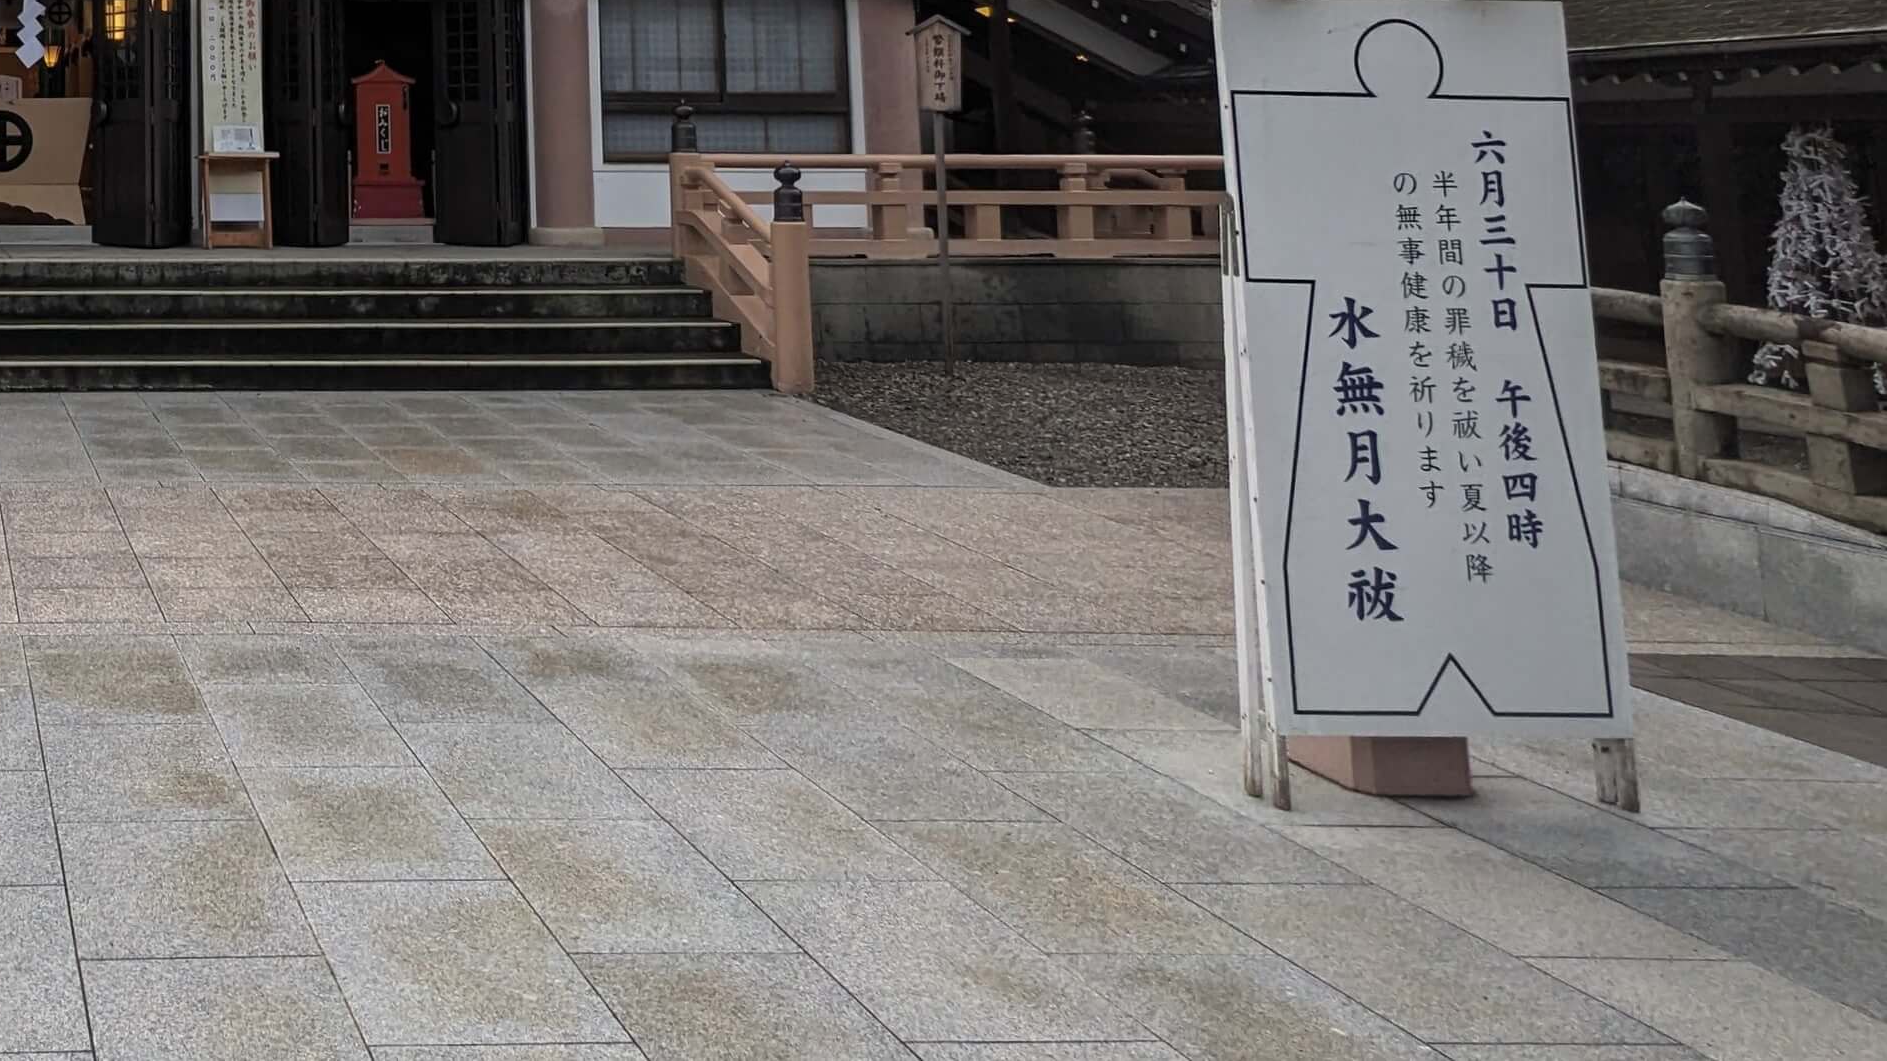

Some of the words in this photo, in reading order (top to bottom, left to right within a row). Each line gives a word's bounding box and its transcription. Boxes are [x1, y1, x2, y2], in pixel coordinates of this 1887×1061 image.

[377, 106, 388, 151] おみくじ
[1327, 297, 1405, 623] 水無月大祓
[1392, 172, 1445, 509] の無事健康を祈ります
[1432, 170, 1494, 583] 半年間の罪穢を祓い夏以降
[1471, 130, 1519, 330] 六月三十日
[1495, 379, 1544, 549] 午後四時
